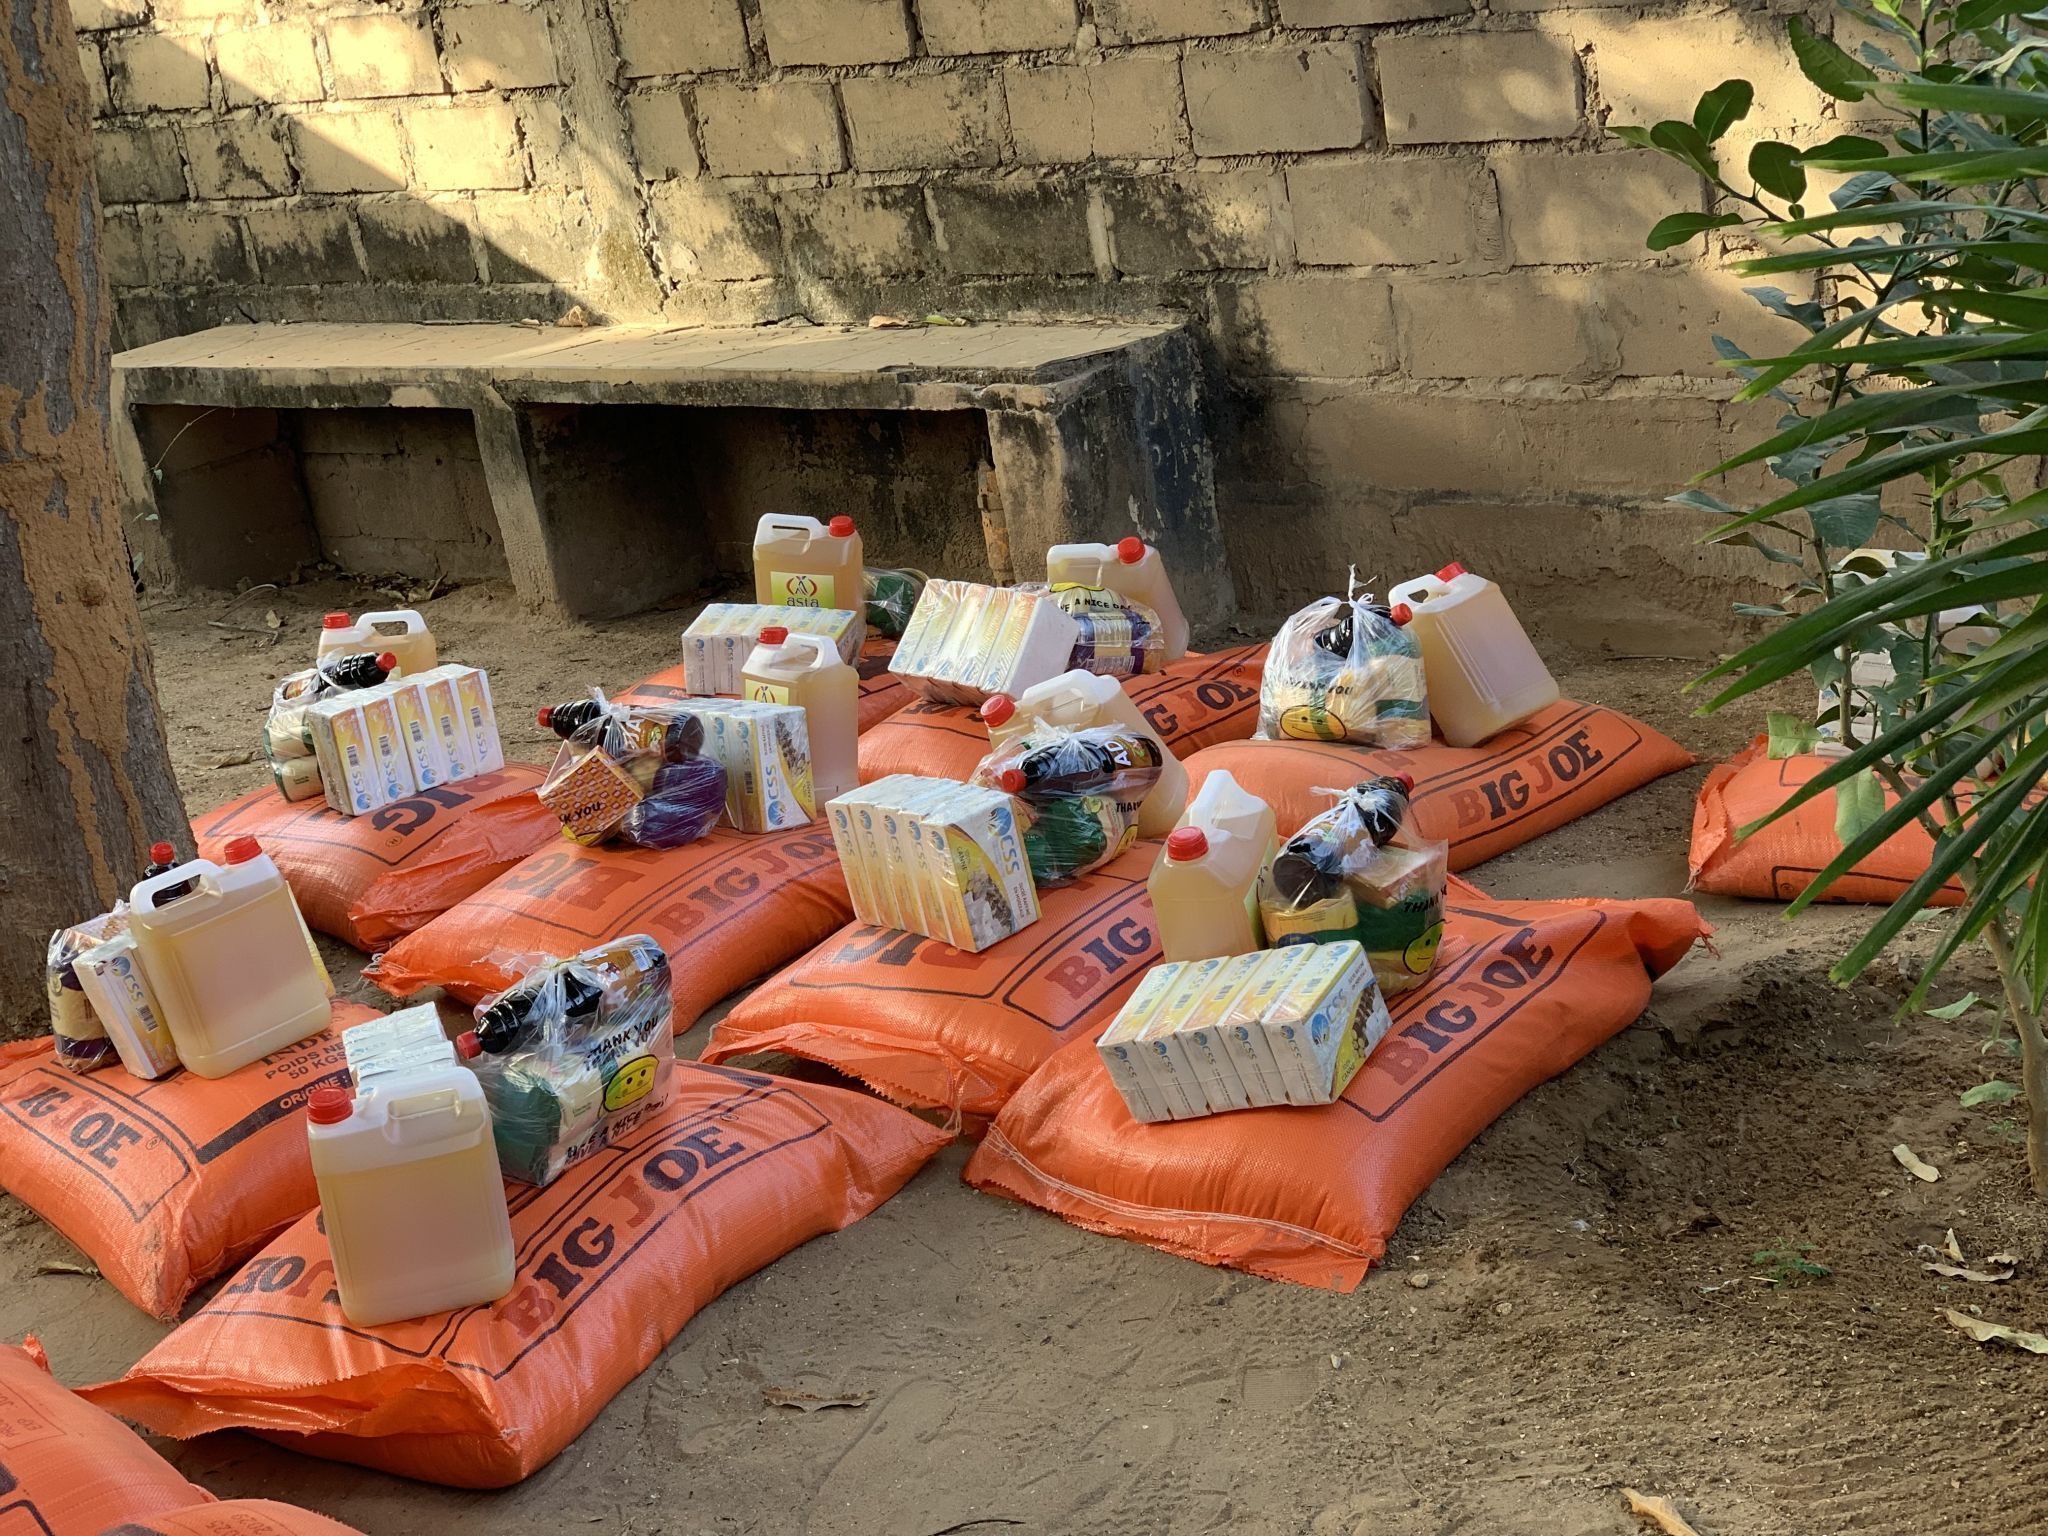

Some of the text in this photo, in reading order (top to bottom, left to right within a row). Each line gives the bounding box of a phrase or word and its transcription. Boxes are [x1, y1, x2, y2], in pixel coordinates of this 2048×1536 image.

[1074, 598, 1081, 606] A
[1084, 598, 1110, 610] NICE
[1175, 679, 1258, 722] JOE
[766, 764, 779, 800] CSS
[1448, 729, 1604, 829] BIG JOE
[574, 801, 601, 820] YOU
[1115, 801, 1143, 813] THAN
[1000, 833, 1021, 876] CSS
[649, 866, 761, 937] BIG
[1044, 916, 1153, 1000] BIG
[123, 973, 145, 1002] CSS
[1373, 998, 1478, 1086] BIG
[1456, 927, 1554, 1008] JOE
[264, 1051, 321, 1080] POIDS
[322, 1041, 346, 1055] NE
[288, 1051, 348, 1080] 50 KGS
[279, 1075, 341, 1110] ORIGINE
[51, 1099, 143, 1169] JOE
[612, 1109, 643, 1132] NICE
[493, 1126, 747, 1339] BIG JOE
